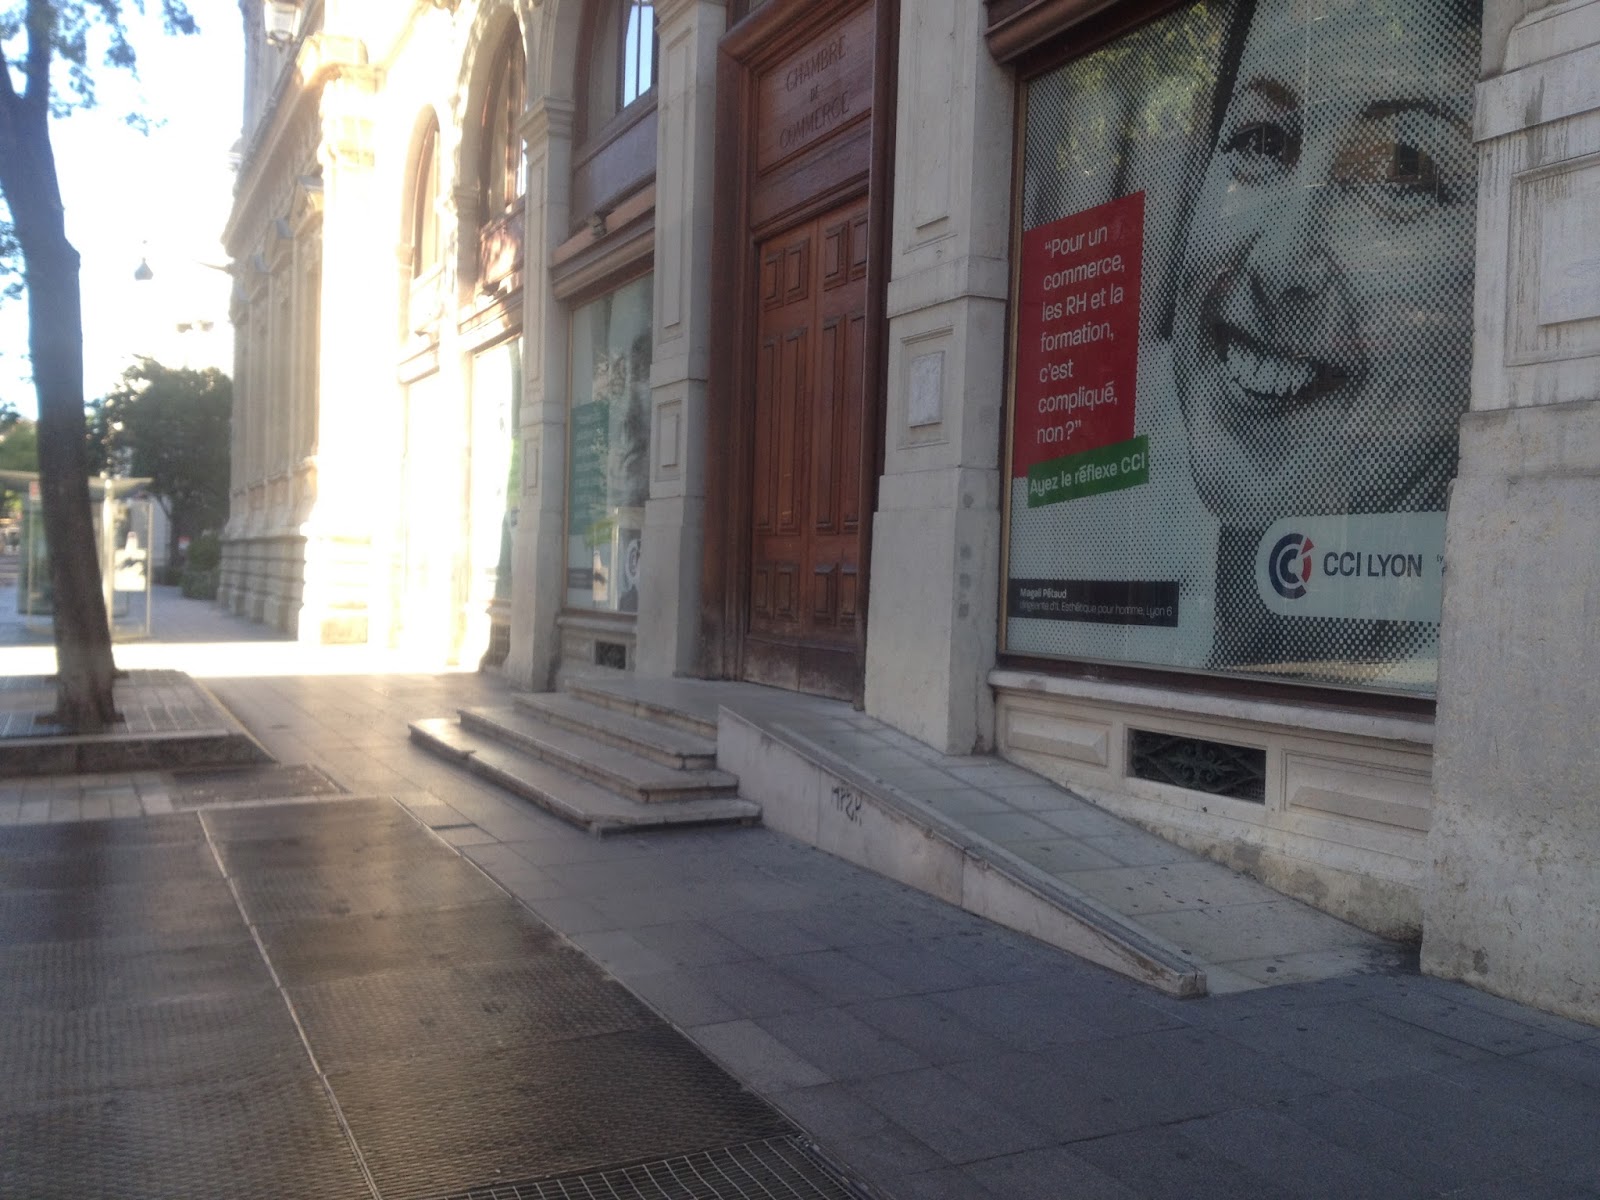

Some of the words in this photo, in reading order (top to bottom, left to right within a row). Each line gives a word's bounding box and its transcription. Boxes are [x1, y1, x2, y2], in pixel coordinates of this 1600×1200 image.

[786, 35, 847, 93] CHAMBRE
[780, 91, 850, 149] COMMERCE
[1088, 226, 1108, 246] un
[1043, 254, 1125, 290] commerce,
[1042, 301, 1062, 322] les
[1066, 292, 1087, 316] RH
[1091, 288, 1107, 308] et
[1110, 283, 1124, 305] la
[1041, 321, 1114, 352] formation,
[1039, 359, 1073, 383] c'est
[1038, 381, 1118, 414] compliqué,
[1030, 477, 1058, 497] Ayez
[1061, 471, 1072, 487] le
[1074, 462, 1118, 485] réflexe
[1121, 452, 1146, 474] CCI
[1323, 551, 1362, 577] CCI
[1367, 552, 1423, 578] LYON
[1061, 602, 1097, 613] Esthétique
[1097, 606, 1115, 616] pour
[1115, 604, 1145, 616] homme,
[1146, 606, 1166, 619] Lyon
[1166, 606, 1173, 617] 6
